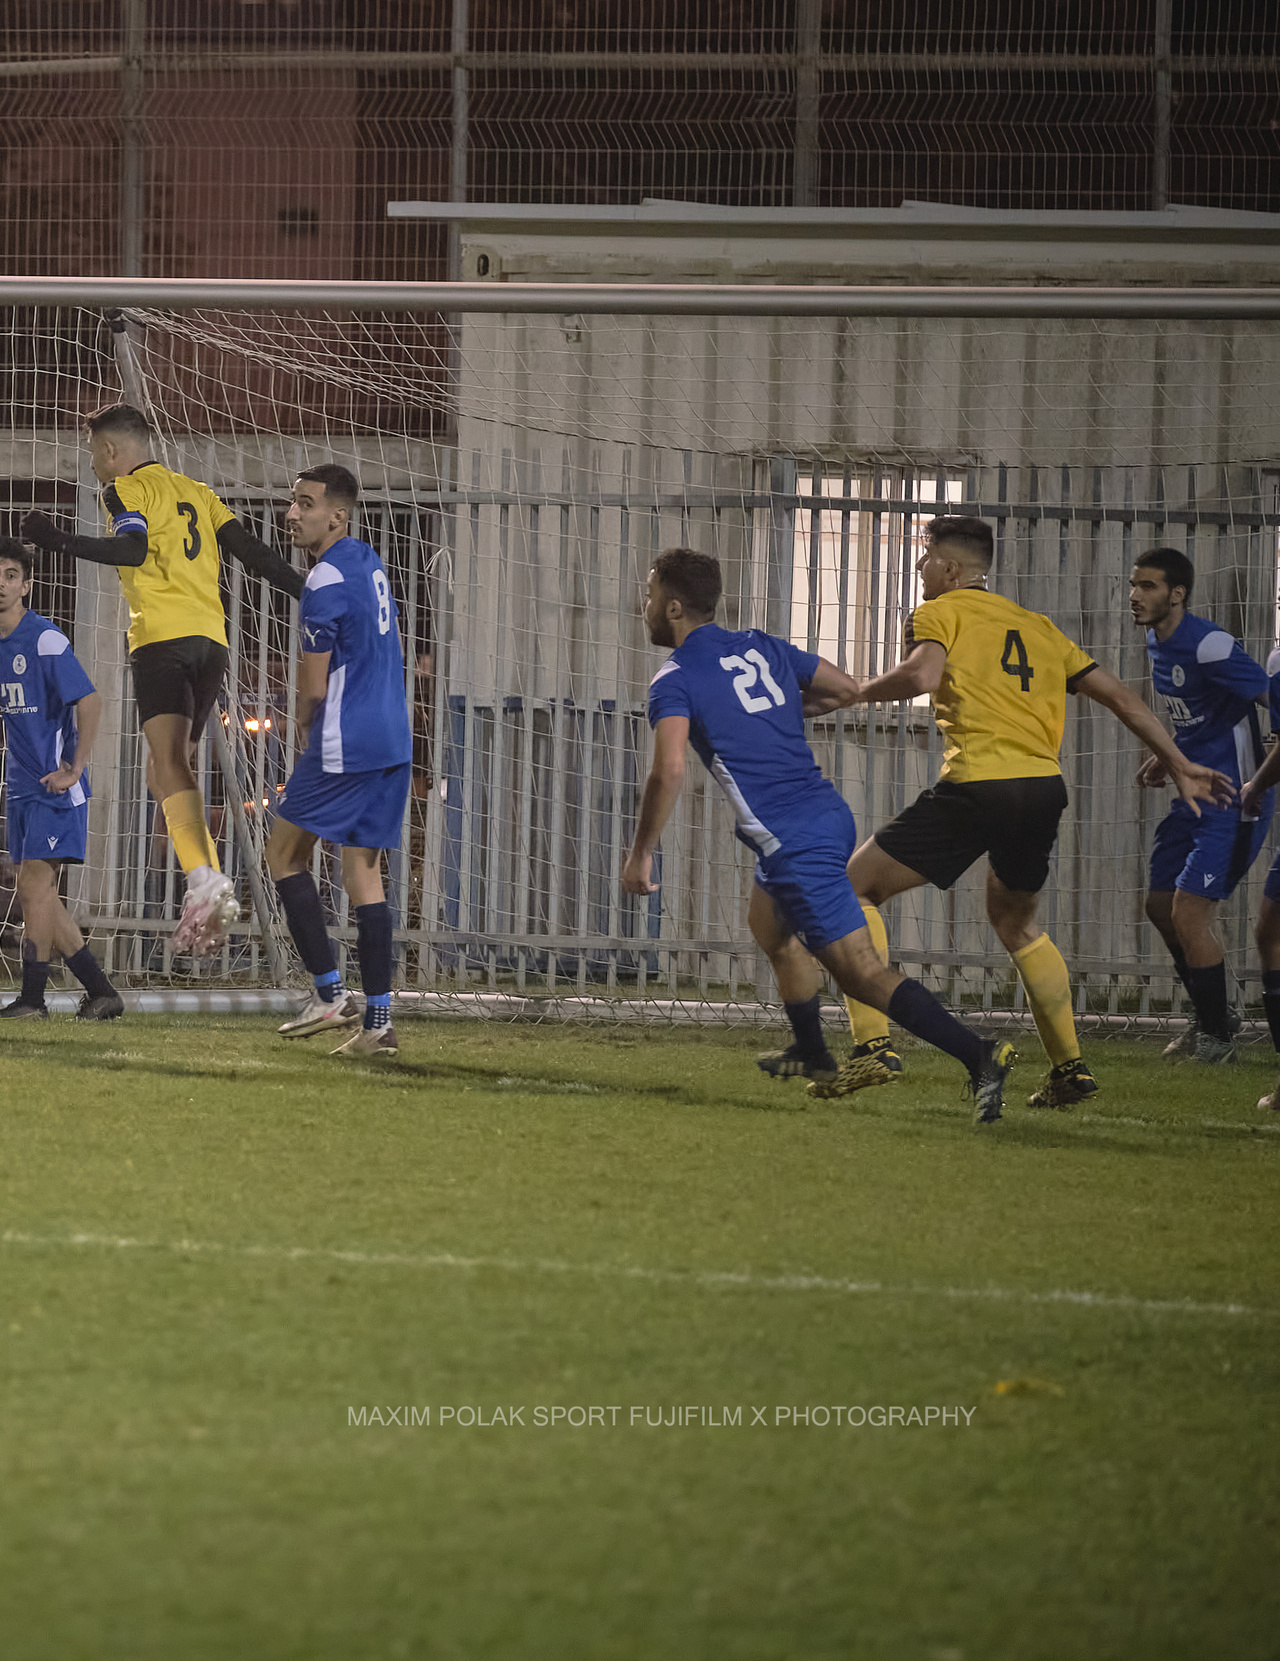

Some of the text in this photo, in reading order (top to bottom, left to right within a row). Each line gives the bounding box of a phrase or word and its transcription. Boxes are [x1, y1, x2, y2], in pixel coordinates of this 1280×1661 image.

[177, 501, 201, 561] 3
[372, 569, 390, 635] 8
[719, 648, 786, 713] 21
[1001, 630, 1034, 692] 4
